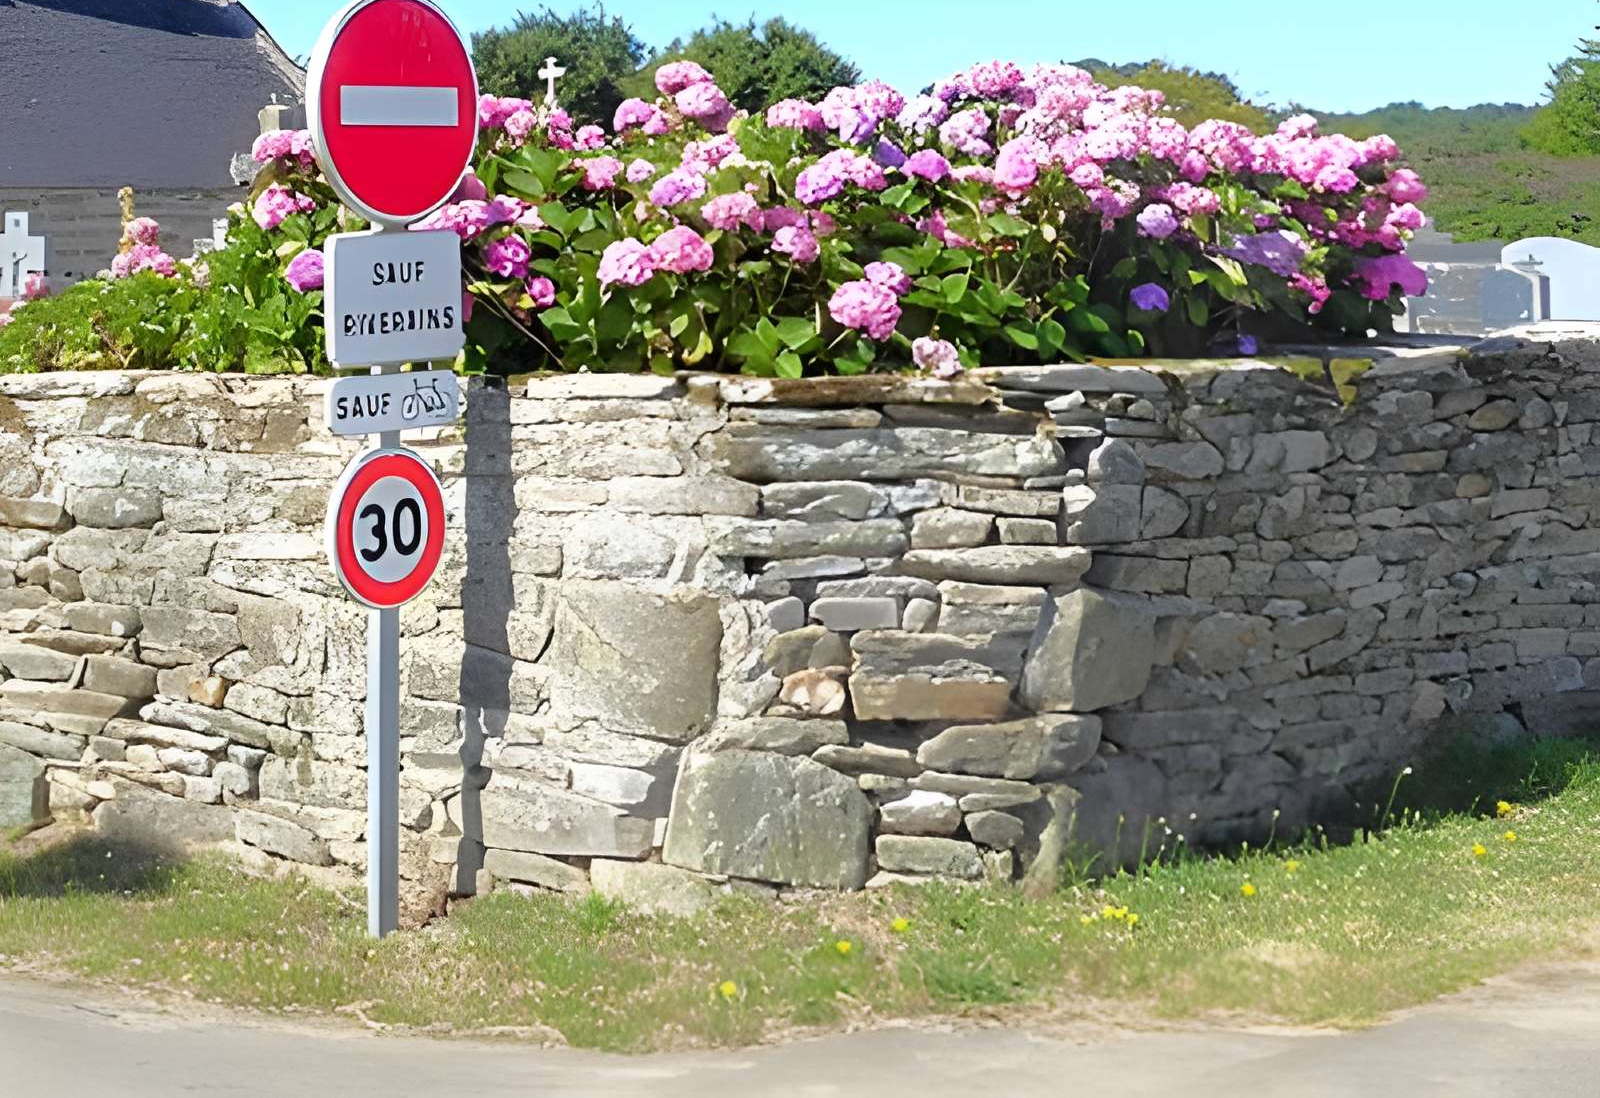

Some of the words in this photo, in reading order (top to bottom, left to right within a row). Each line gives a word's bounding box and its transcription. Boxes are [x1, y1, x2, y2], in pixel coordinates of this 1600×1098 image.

[372, 261, 425, 286] SAUF
[336, 392, 391, 420] SAUF
[359, 497, 422, 562] 30
